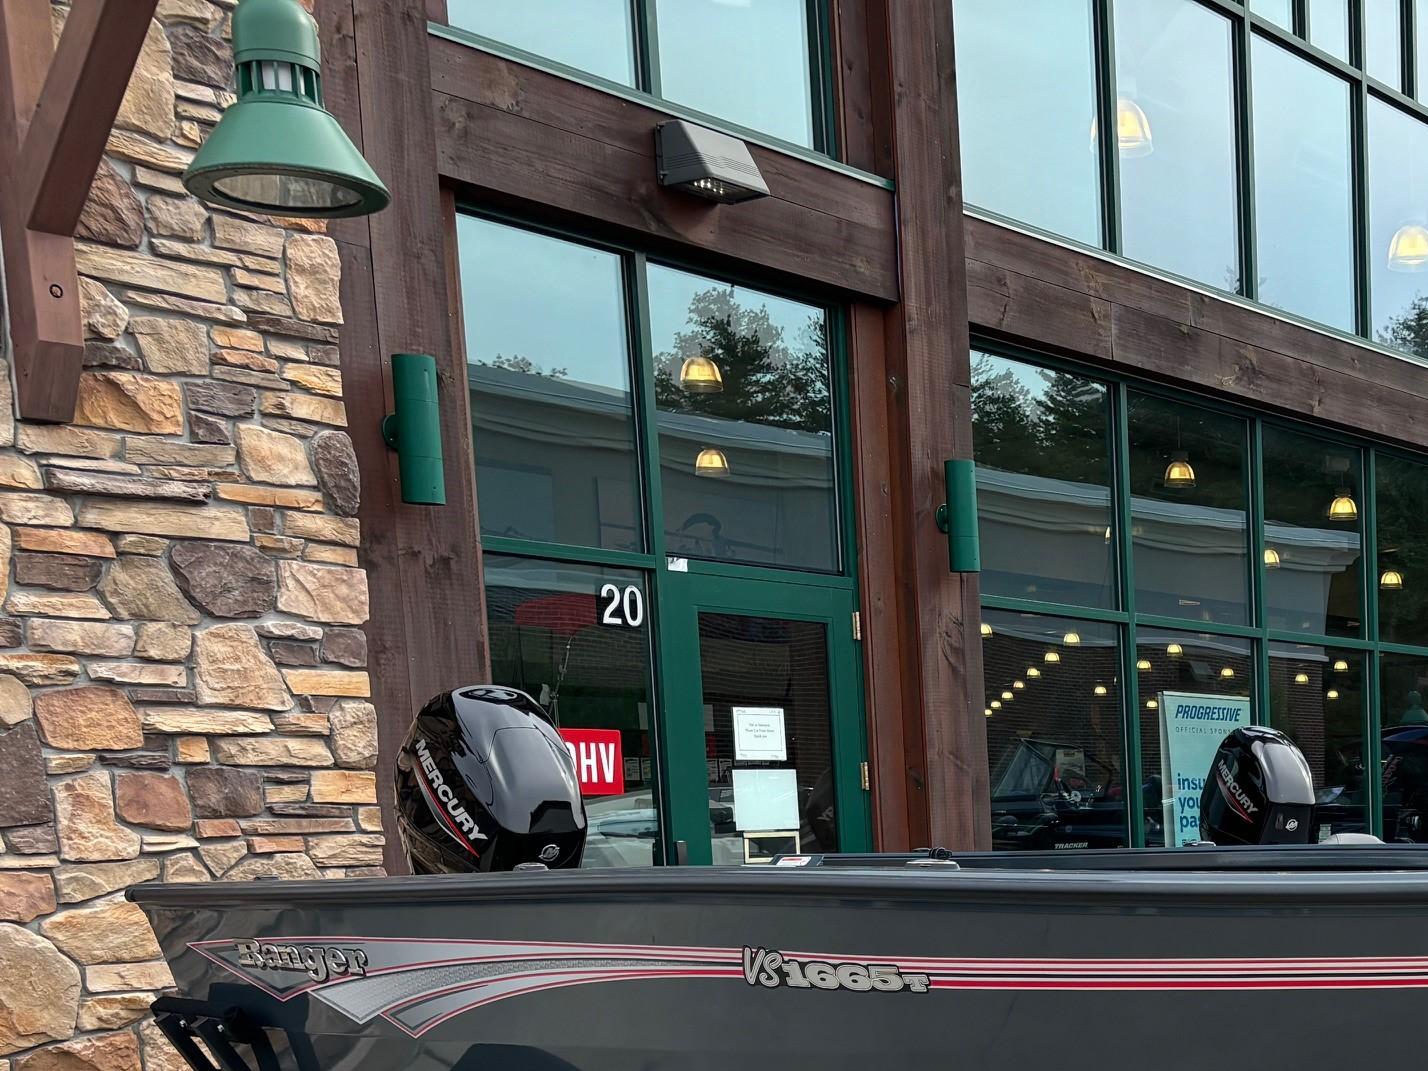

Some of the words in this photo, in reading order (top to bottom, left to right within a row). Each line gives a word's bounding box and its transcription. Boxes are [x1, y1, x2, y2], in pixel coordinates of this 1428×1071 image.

[601, 584, 643, 626] 20
[1175, 704, 1242, 722] PROGRESSIVE
[1175, 726, 1206, 735] OFFICIAL
[415, 738, 489, 842] MERCURY
[1217, 759, 1259, 814] MERCURY
[1179, 815, 1200, 833] pa
[233, 938, 369, 983] Ranger
